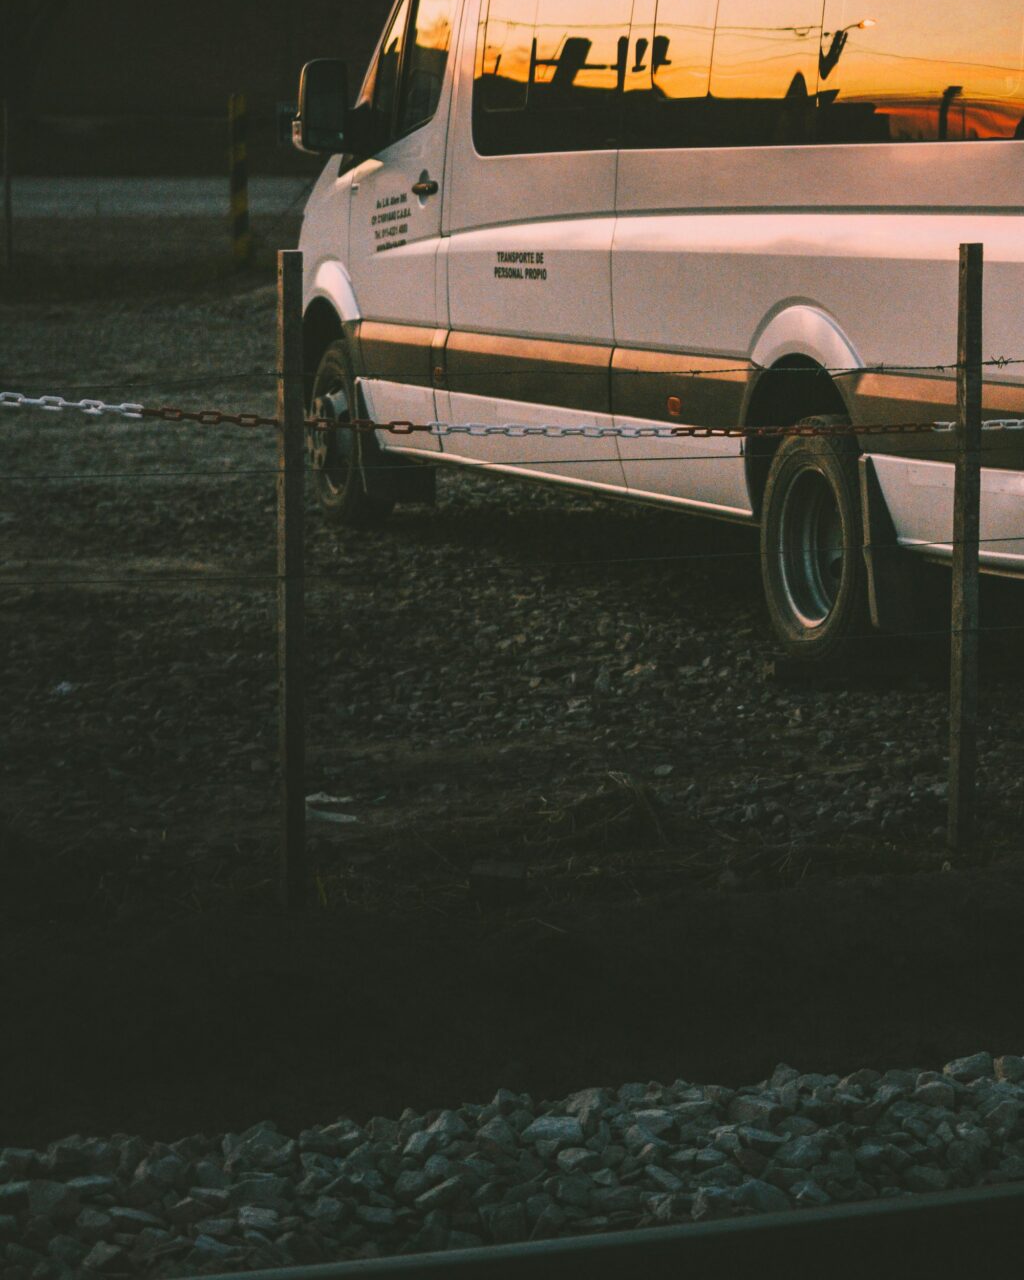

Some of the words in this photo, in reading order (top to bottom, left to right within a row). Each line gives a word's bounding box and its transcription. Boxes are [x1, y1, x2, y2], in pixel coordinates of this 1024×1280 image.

[497, 252, 534, 263] TRANSPORTE
[536, 252, 544, 264] DE
[525, 268, 547, 280] PROPIO
